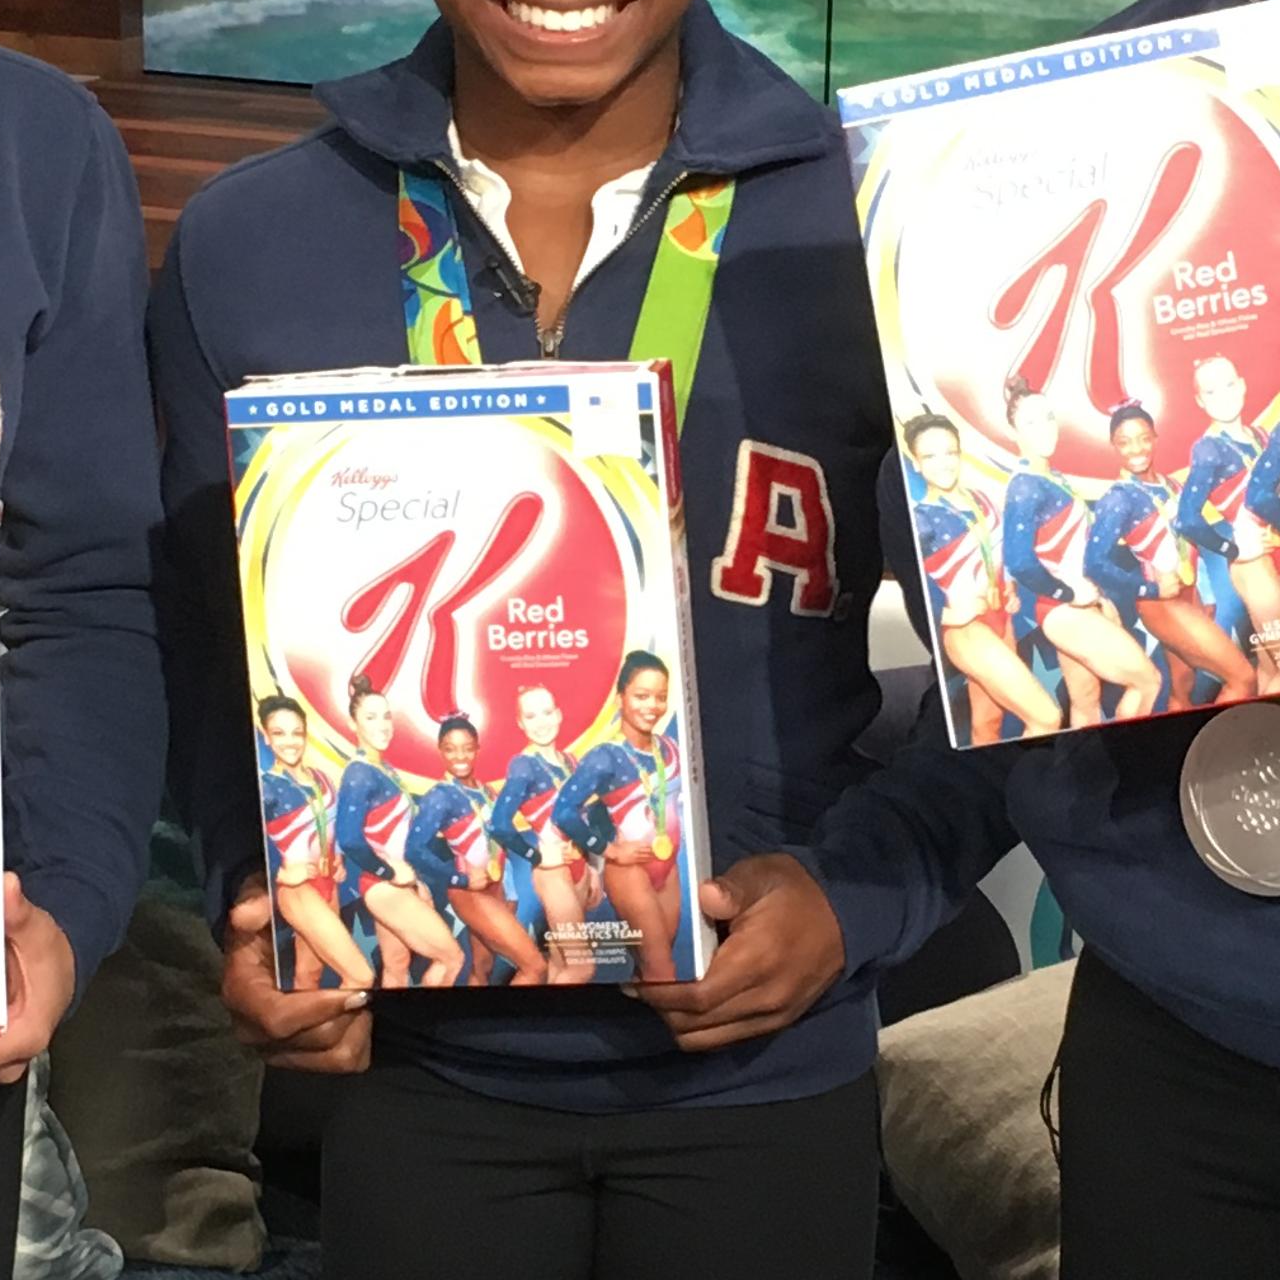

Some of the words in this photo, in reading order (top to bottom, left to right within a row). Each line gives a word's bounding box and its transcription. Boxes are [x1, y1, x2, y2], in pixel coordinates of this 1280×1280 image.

[881, 79, 950, 108] GOLD
[963, 60, 1050, 90] MEDAL
[1062, 33, 1174, 71] EDITION
[1172, 249, 1238, 292] Red
[1152, 283, 1269, 325] Berries
[265, 402, 328, 417] GOLD
[339, 397, 417, 414] MEDAL
[429, 392, 528, 410] EDITION
[336, 489, 461, 531] Special
[341, 490, 545, 722] K
[506, 594, 565, 624] Red
[487, 623, 590, 651] Berries
[576, 921, 629, 930] WOMEN'S
[613, 929, 643, 938] TEAM
